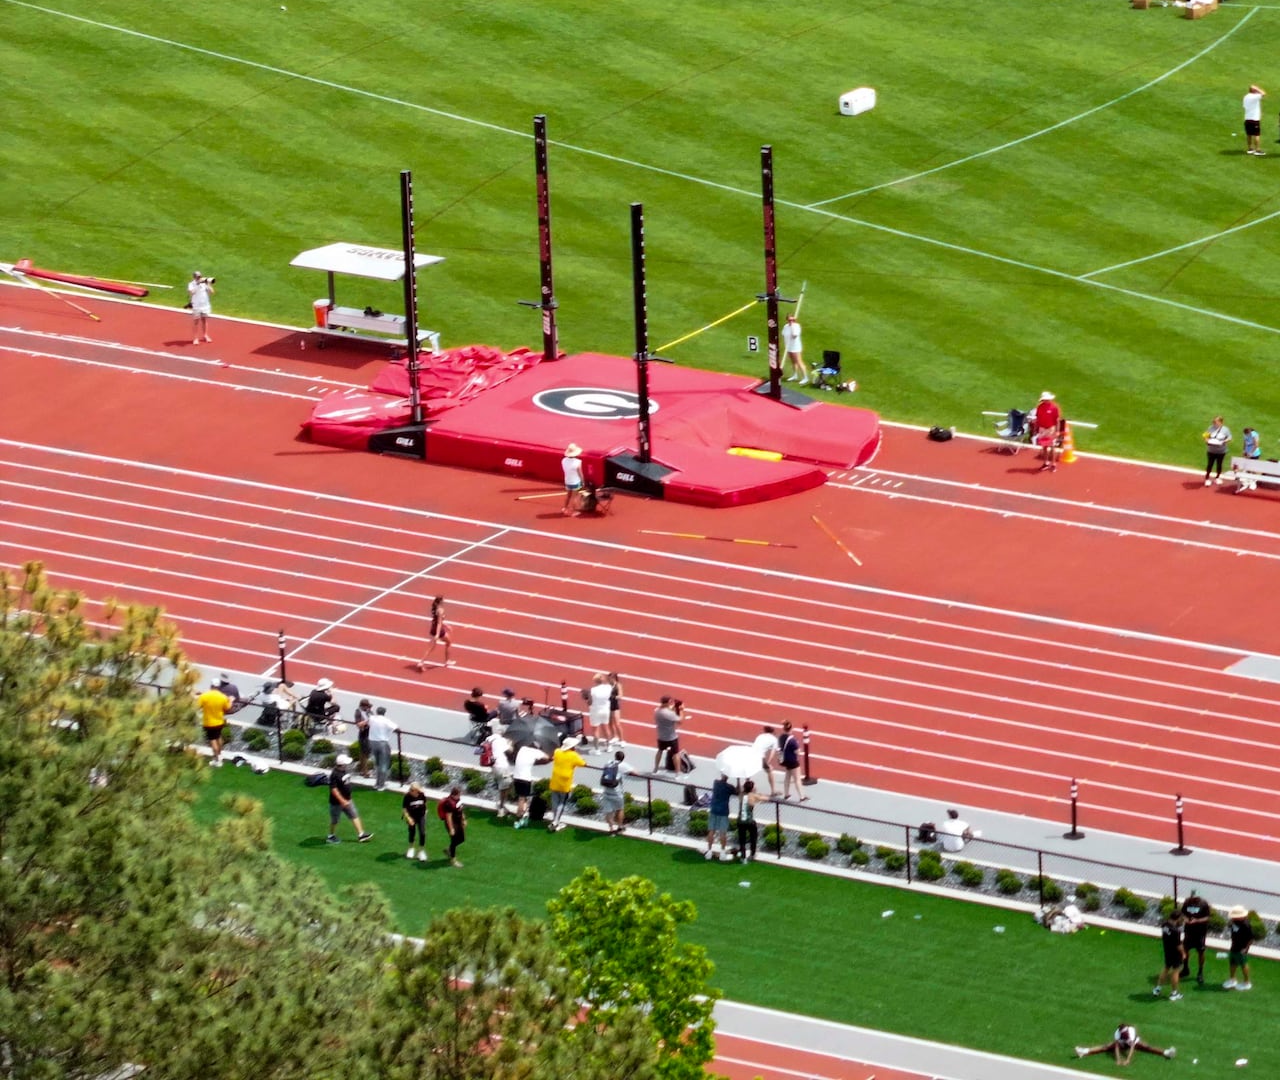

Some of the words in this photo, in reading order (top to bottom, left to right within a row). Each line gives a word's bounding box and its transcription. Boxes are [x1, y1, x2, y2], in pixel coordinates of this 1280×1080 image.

[749, 337, 758, 350] B
[395, 436, 414, 446] GILL
[504, 457, 523, 467] GILL
[616, 472, 635, 482] GILL
